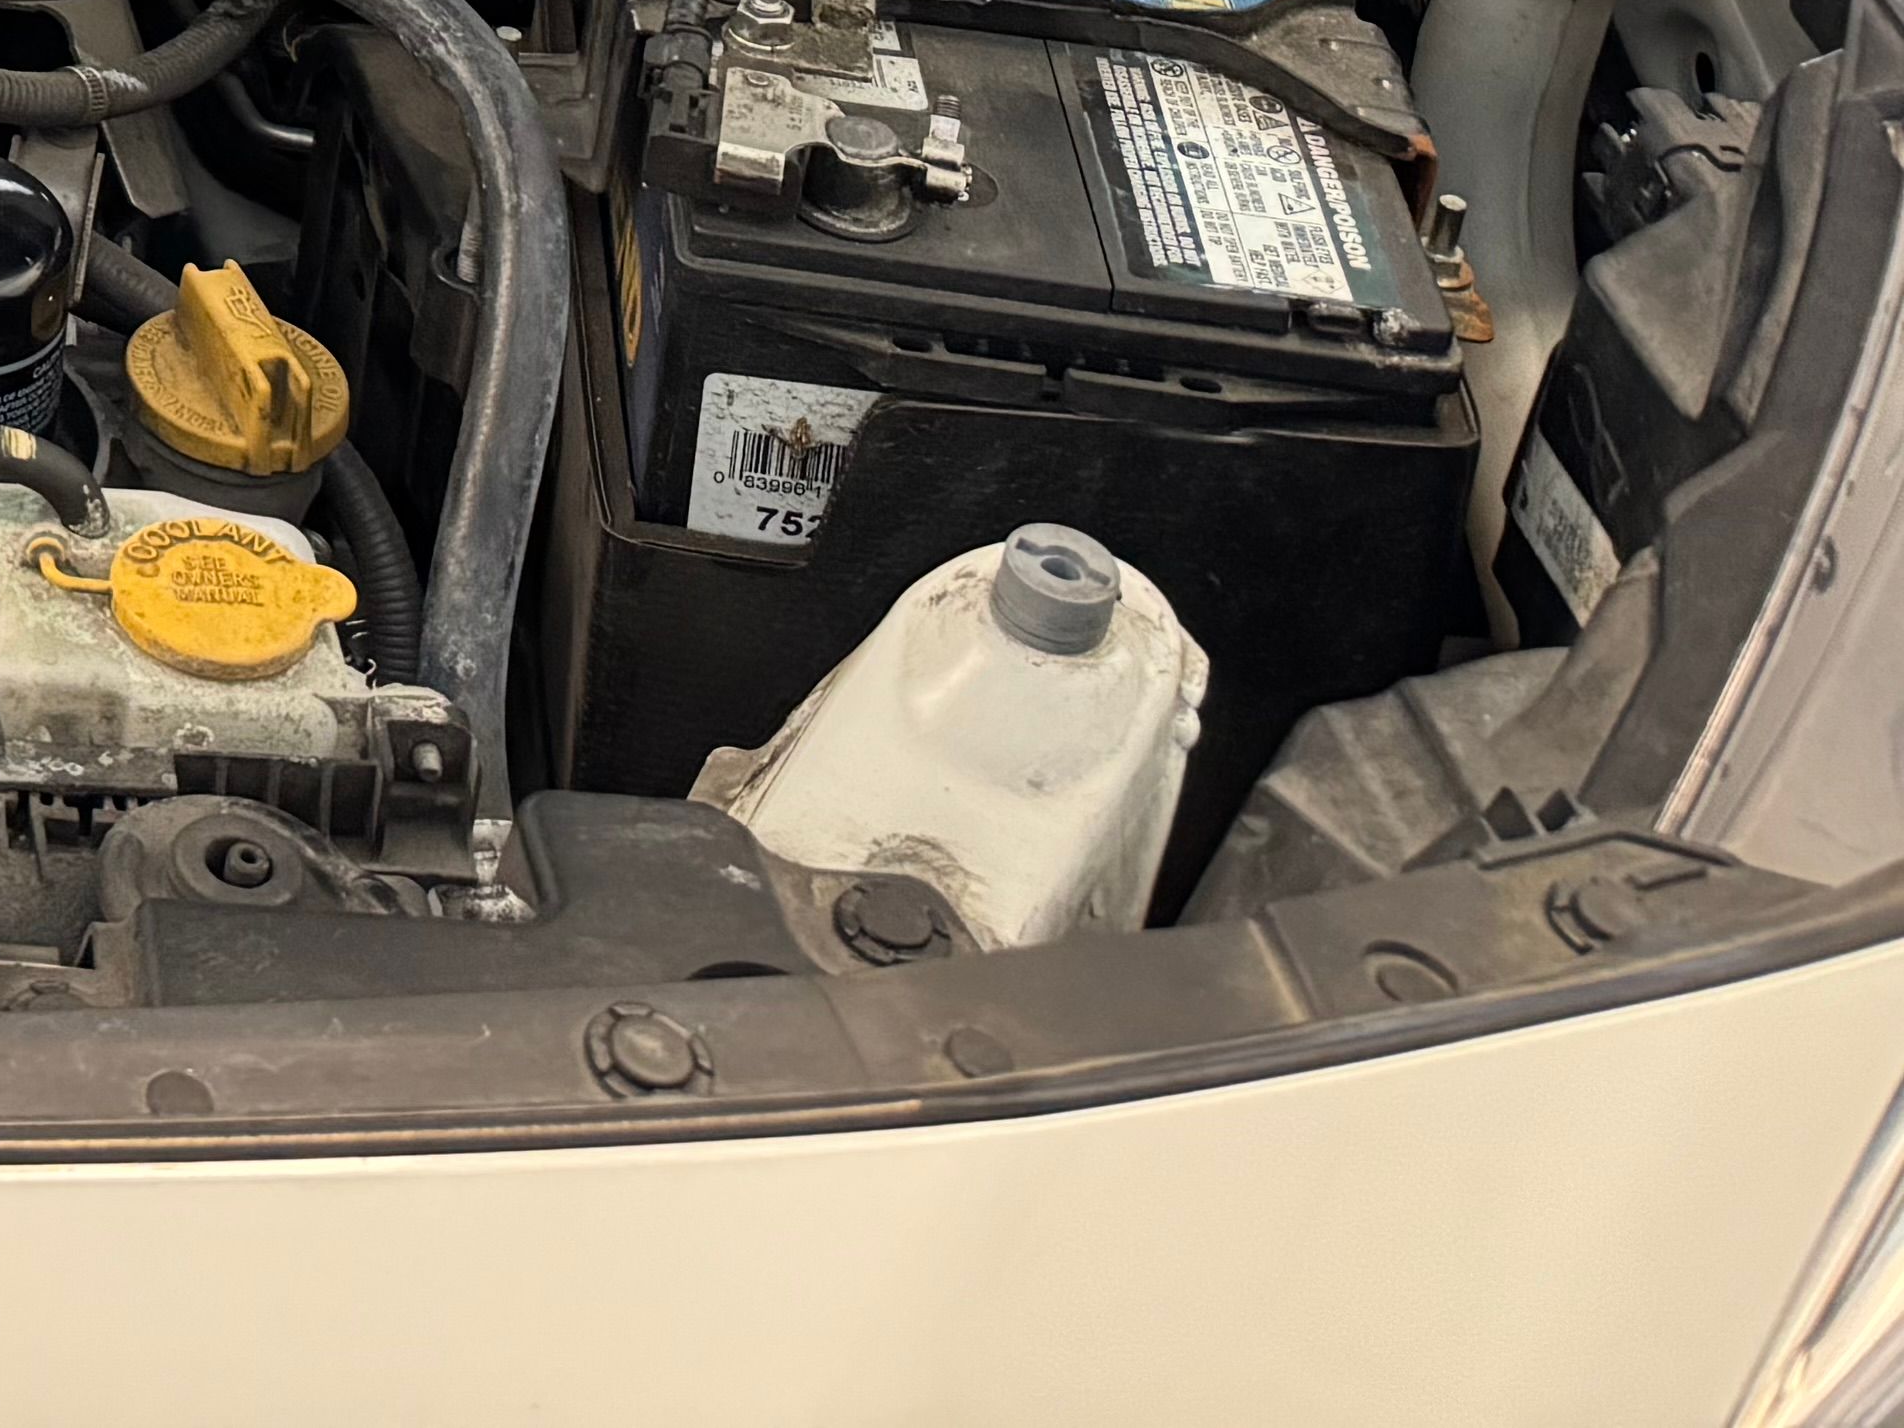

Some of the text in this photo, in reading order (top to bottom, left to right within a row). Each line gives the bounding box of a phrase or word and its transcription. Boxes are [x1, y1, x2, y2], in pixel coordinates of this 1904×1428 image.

[1304, 134, 1371, 271] DANGER/POISON
[280, 324, 341, 413] NGINE OIL
[713, 471, 725, 484] 0
[125, 519, 291, 565] COOLANT
[182, 555, 227, 573] SEE
[173, 586, 264, 607] MANUAL
